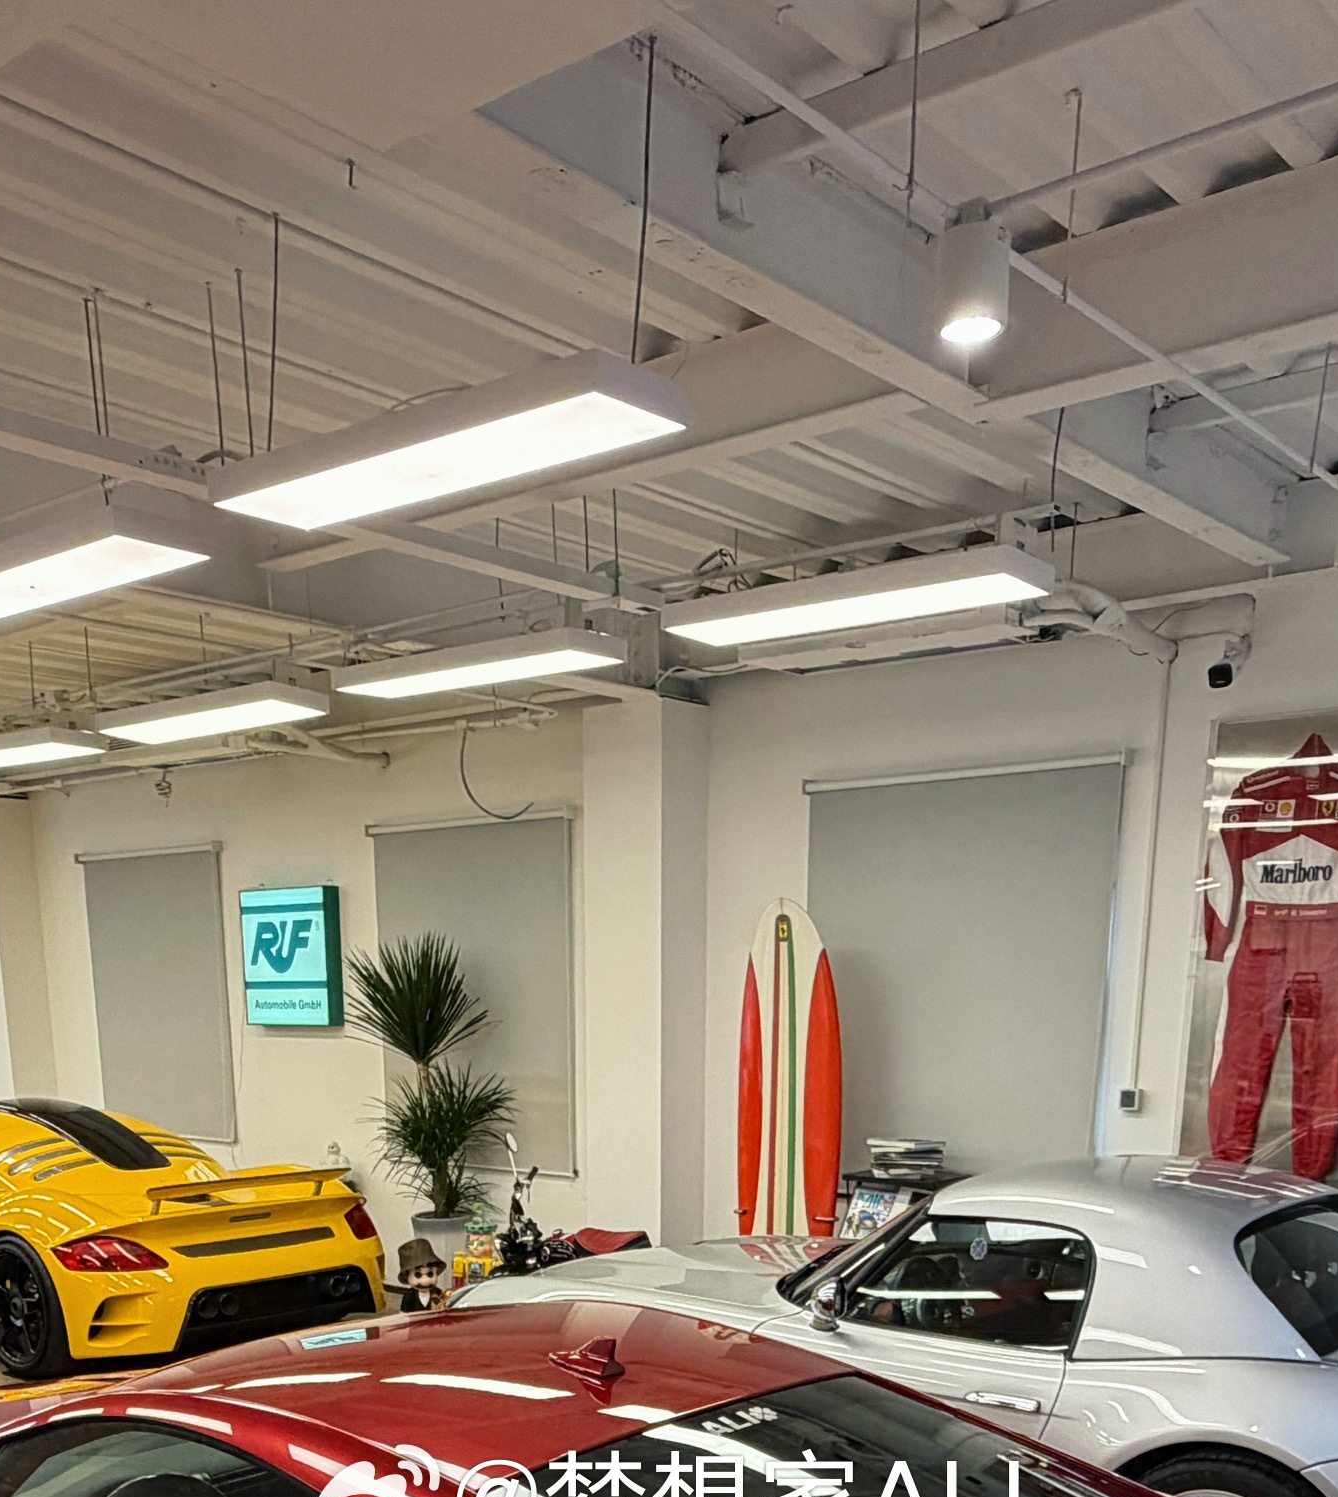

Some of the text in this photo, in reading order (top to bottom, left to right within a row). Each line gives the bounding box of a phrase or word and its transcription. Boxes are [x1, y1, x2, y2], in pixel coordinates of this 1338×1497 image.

[1260, 859, 1333, 884] Marlboro
[250, 919, 313, 974] RUF
[255, 999, 322, 1010] Automobile GmbH
[701, 1410, 761, 1437] ALI
